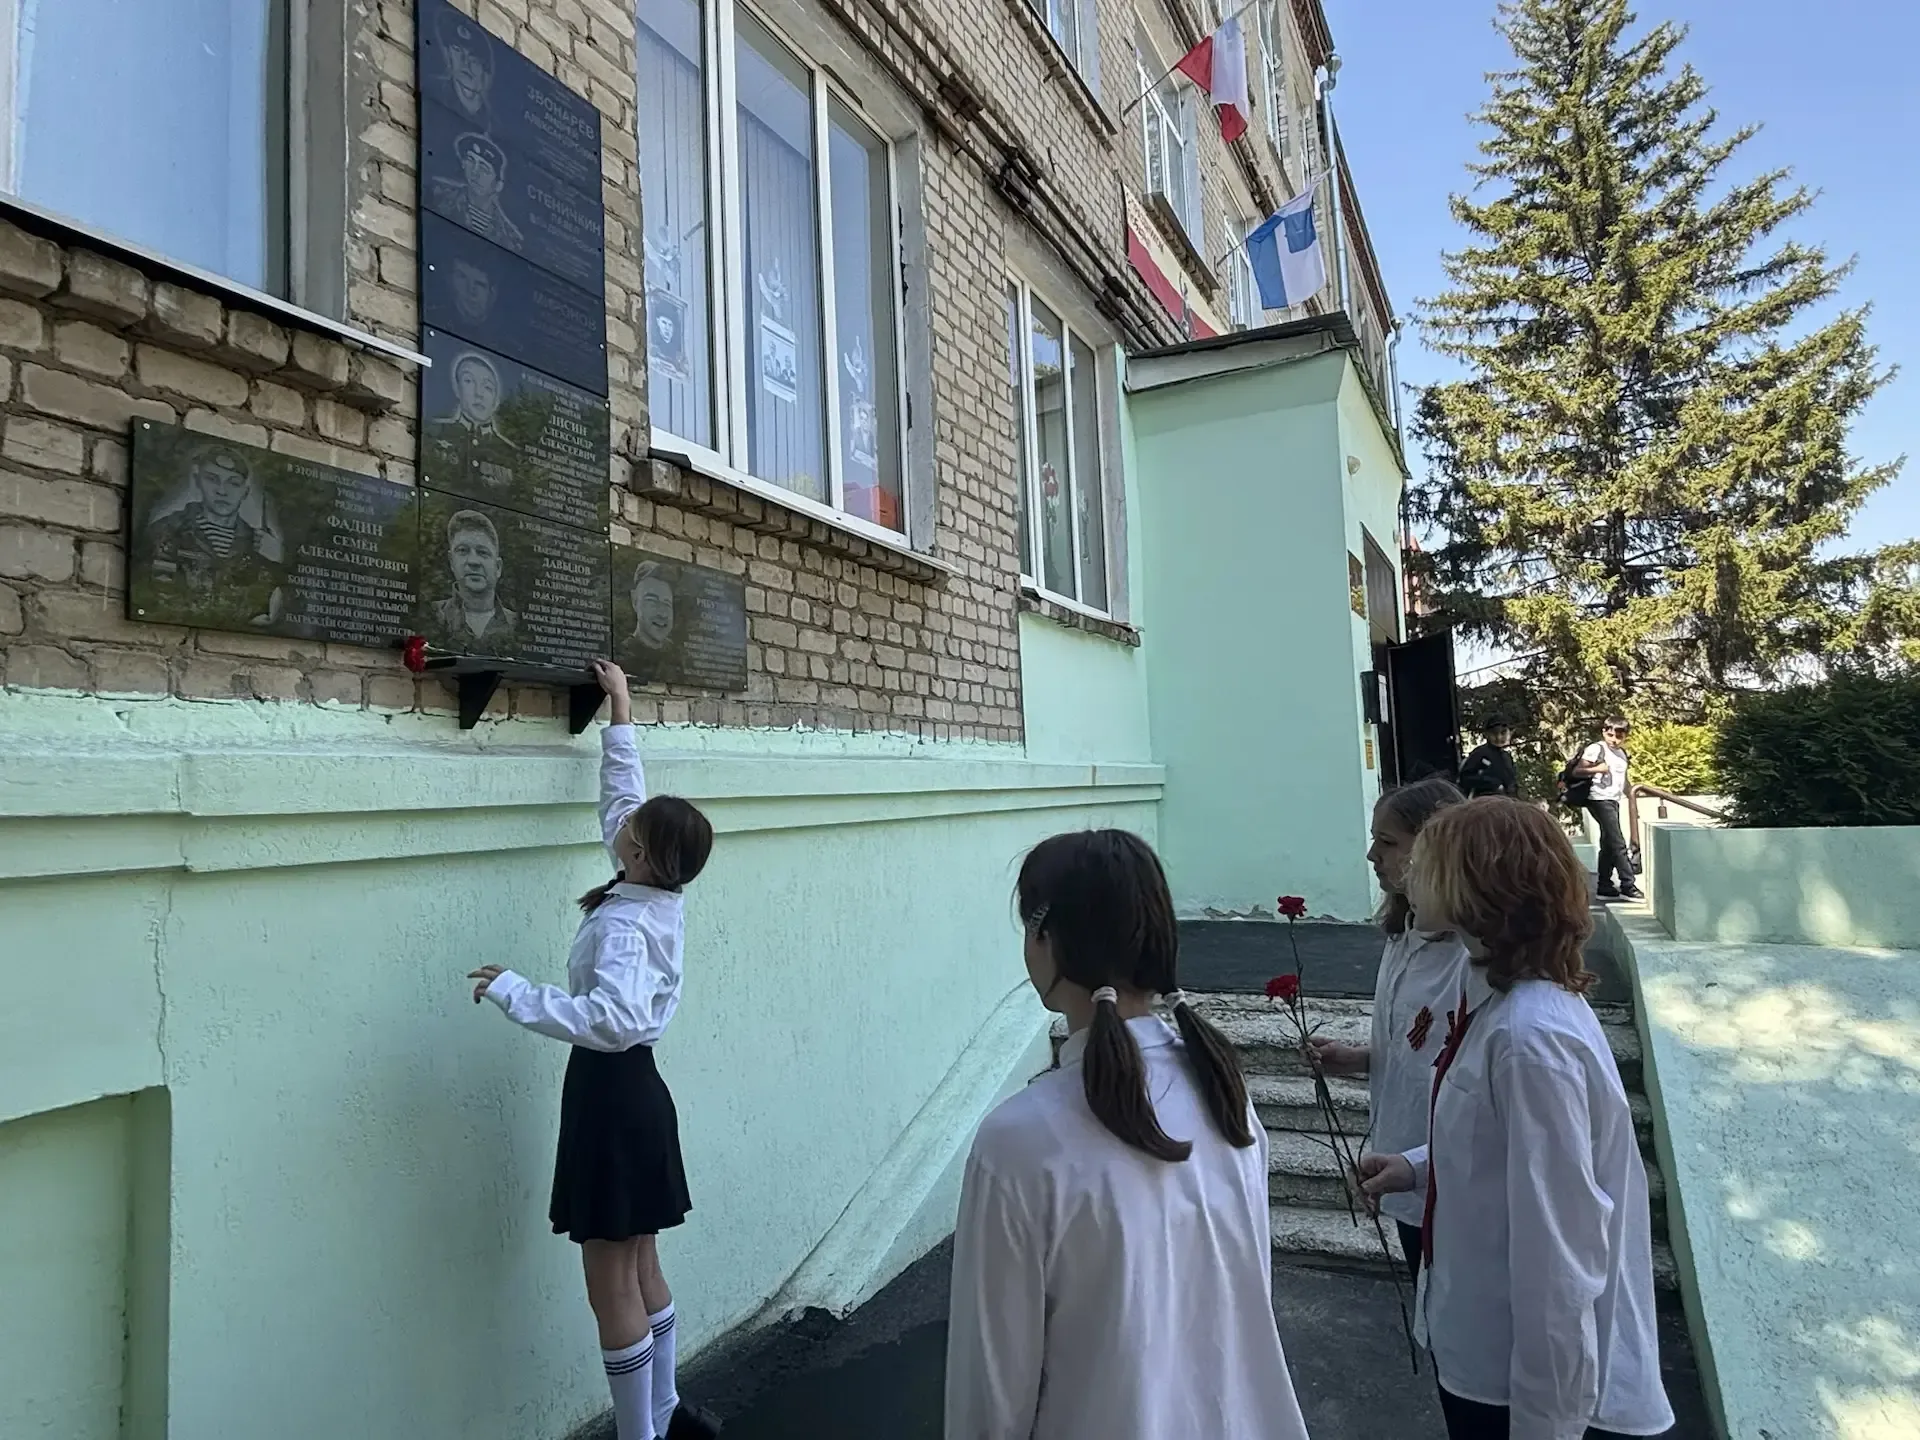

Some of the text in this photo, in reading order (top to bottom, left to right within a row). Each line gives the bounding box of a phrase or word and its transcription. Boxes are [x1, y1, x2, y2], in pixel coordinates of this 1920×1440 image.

[527, 184, 601, 237] СТЕНИЧКИН
[548, 414, 588, 438] ЛИСИН
[539, 435, 597, 463] АЛЕКСЕЕВИЧ
[542, 426, 595, 451] АЛЕКСАНДР
[326, 514, 384, 538] ФАДИН
[297, 544, 410, 574] АЛЕКСАНДРОВИЧ
[541, 557, 592, 576] ДАВЫДОВ
[297, 564, 330, 578] ПОГИБ
[330, 569, 350, 582] ПРИ
[544, 571, 591, 587] АЛЕКСАНДР
[287, 574, 328, 590] БОЕВЫХ
[375, 589, 389, 599] ВО
[389, 591, 417, 605] ВРЕМЯ
[533, 578, 599, 598] ВЛАДИМИРОВИЧ
[306, 603, 401, 625] ВОЕННОЙ ОПЕРАЦИИ
[346, 596, 409, 614] СПЕЦИАЛЬНОЙ
[329, 630, 381, 645] ПОСМЕРТНО
